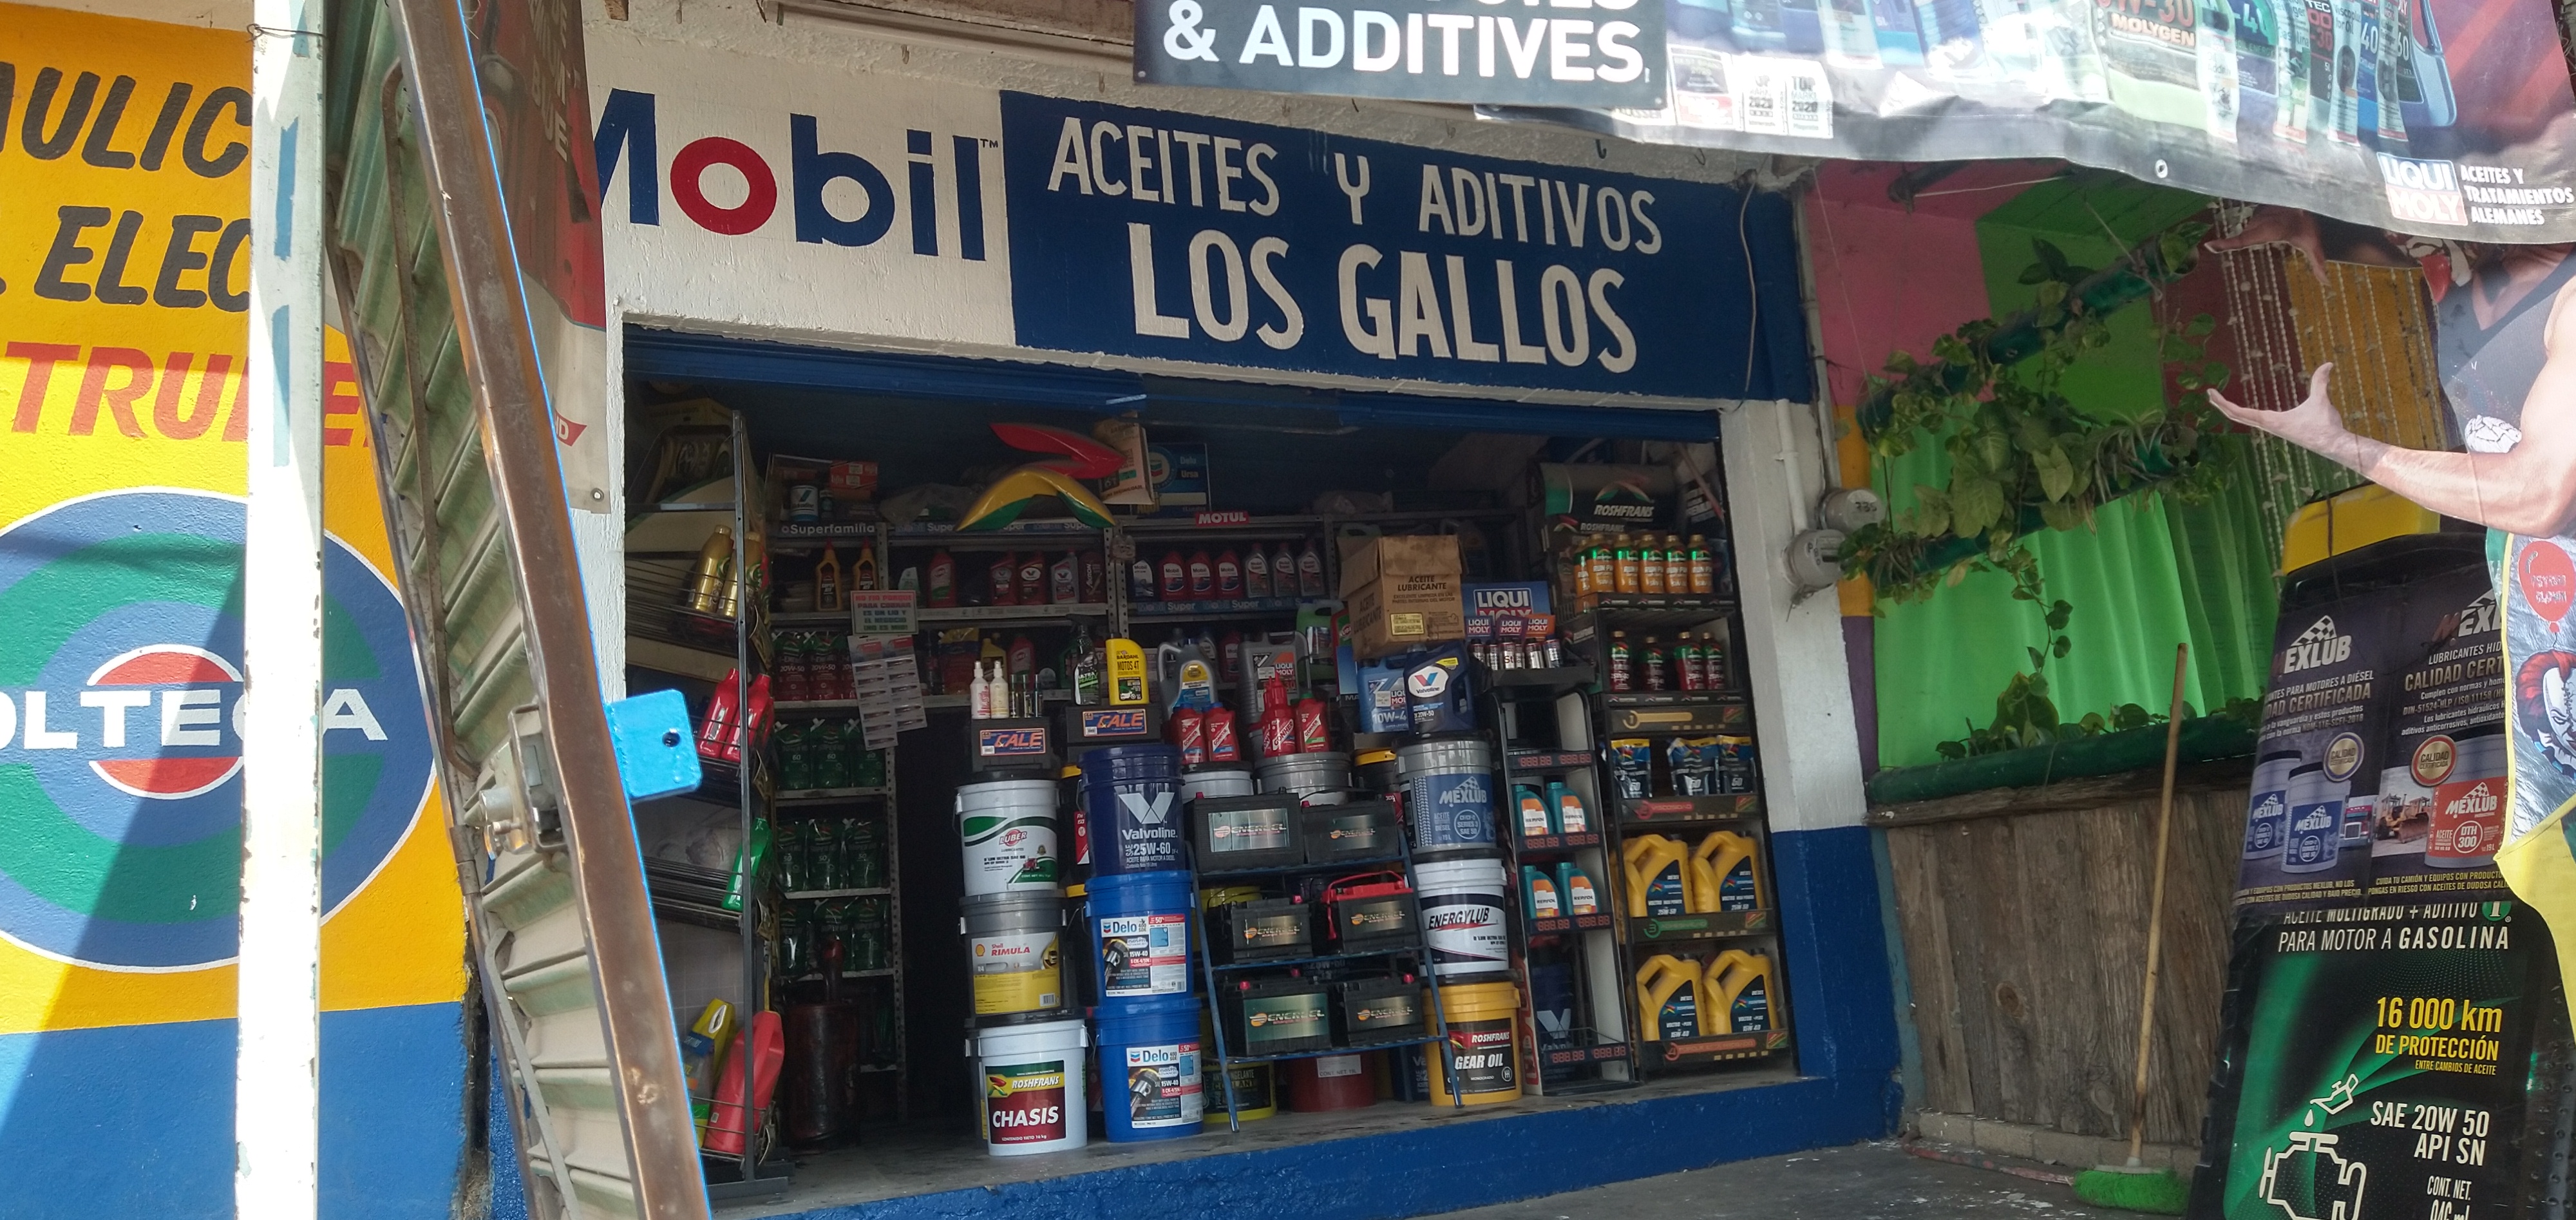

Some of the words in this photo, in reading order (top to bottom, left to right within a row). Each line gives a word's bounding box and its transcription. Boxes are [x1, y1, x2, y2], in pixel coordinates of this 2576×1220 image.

[2111, 12, 2195, 46] MOLYGEN
[1163, 0, 1219, 62] &
[1238, 5, 1643, 82] ADDITIVES
[0, 61, 252, 178] ULIC
[594, 88, 986, 261] Mobil
[2381, 156, 2455, 191] LIQUI
[2460, 165, 2511, 184] ACEITES
[2514, 168, 2524, 185] Y
[1047, 117, 1280, 216] ACEITES
[1334, 152, 1370, 225] Y
[1418, 165, 1662, 254] ADITIVOS
[2463, 186, 2575, 205] TRATAMIENTOS
[2389, 188, 2459, 222] MOLY
[2471, 207, 2545, 225] ALEMANES
[1127, 222, 1304, 350] LOS
[1338, 243, 1637, 373] GALLOS
[1198, 512, 1247, 524] MOTUL
[1593, 504, 1654, 517] ROSHFRANS
[790, 522, 875, 536] Superfamilia
[1580, 522, 1625, 533] ROSHFRANS
[1397, 582, 1447, 592] LUBRICANTE
[1408, 575, 1435, 584] ACEITE
[1167, 602, 1196, 613] Super
[1231, 599, 1259, 610] Super
[1476, 590, 1530, 608] LIQUI
[1468, 618, 1490, 627] LIQUI
[1468, 625, 1490, 634] MOLY
[1501, 620, 1522, 628] LIQUI
[1501, 626, 1522, 634] MOLY
[1527, 624, 1548, 632] MOLY
[1528, 618, 1548, 626] LIQUI
[2429, 644, 2484, 665] LUBRICANTES
[1117, 661, 1133, 671] MOTOS
[1133, 661, 1139, 671] 4T
[2405, 663, 2462, 692] CALIDAD
[1416, 686, 1440, 694] Valvoline
[2286, 684, 2304, 697] PARA
[2306, 676, 2339, 692] MOTORES
[2340, 675, 2345, 685] A
[2421, 689, 2446, 701] Cumplen
[2447, 685, 2458, 695] con
[2459, 681, 2482, 692] normas
[2289, 683, 2371, 714] CERTIFICADA
[2458, 694, 2469, 705] ISO
[1097, 712, 1144, 729] CALE
[2424, 715, 2434, 723] Los
[2435, 709, 2467, 721] lubricantes
[1273, 721, 1294, 747] GONHER
[2401, 726, 2425, 736] aditivos
[996, 732, 1043, 748] CALE
[2421, 751, 2449, 763] CALIDAD
[1439, 788, 1487, 805] MEXLUB
[2445, 796, 2497, 817] MEXLUB
[2295, 815, 2332, 832] MEXLUB
[2461, 825, 2477, 836] DTH
[999, 831, 1028, 845] LUBER
[2458, 836, 2477, 849] 300
[1133, 842, 1171, 857] 25W-60
[2429, 873, 2454, 882] EQUIPOS
[2455, 872, 2468, 881] CON
[2398, 884, 2418, 893] RIESGO
[2419, 884, 2431, 892] CON
[2432, 882, 2456, 891] ACEITES
[2457, 882, 2465, 890] DE
[2467, 881, 2492, 890] DUDOSA
[1428, 908, 1490, 929] ENERGYLUB
[1112, 920, 1137, 934] Delo
[2278, 930, 2316, 953] PARA
[2321, 928, 2377, 951] MOTOR
[2381, 928, 2392, 950] A
[2399, 926, 2509, 950] GASOLINA
[991, 947, 1031, 957] RIMULA
[2377, 996, 2403, 1029] 16
[2409, 997, 2455, 1031] 000
[2461, 999, 2503, 1033] km
[1471, 1032, 1510, 1044] ROSHFRANS
[1142, 1049, 1169, 1063] Delo
[2375, 1034, 2396, 1055] DE
[2398, 1034, 2499, 1062] PROTECCIÓN
[1454, 1054, 1485, 1071] GEAR
[1488, 1053, 1504, 1068] OIL
[2415, 1059, 2434, 1071] ENTRE
[2435, 1061, 2463, 1074] CAMBIOS
[2464, 1063, 2473, 1074] DE
[2474, 1063, 2497, 1076] ACEITE
[1012, 1076, 1060, 1089] ROSHFRANS
[1160, 1079, 1179, 1087] 15W-40
[992, 1105, 1059, 1128] CHASIS
[2370, 1100, 2408, 1128] SAE
[2411, 1104, 2458, 1134] 20W
[2462, 1109, 2490, 1138] 50
[2414, 1132, 2451, 1161] API
[2456, 1137, 2486, 1167] SN
[2427, 1175, 2452, 1198] CONT.
[2452, 1179, 2472, 1201] NET.
